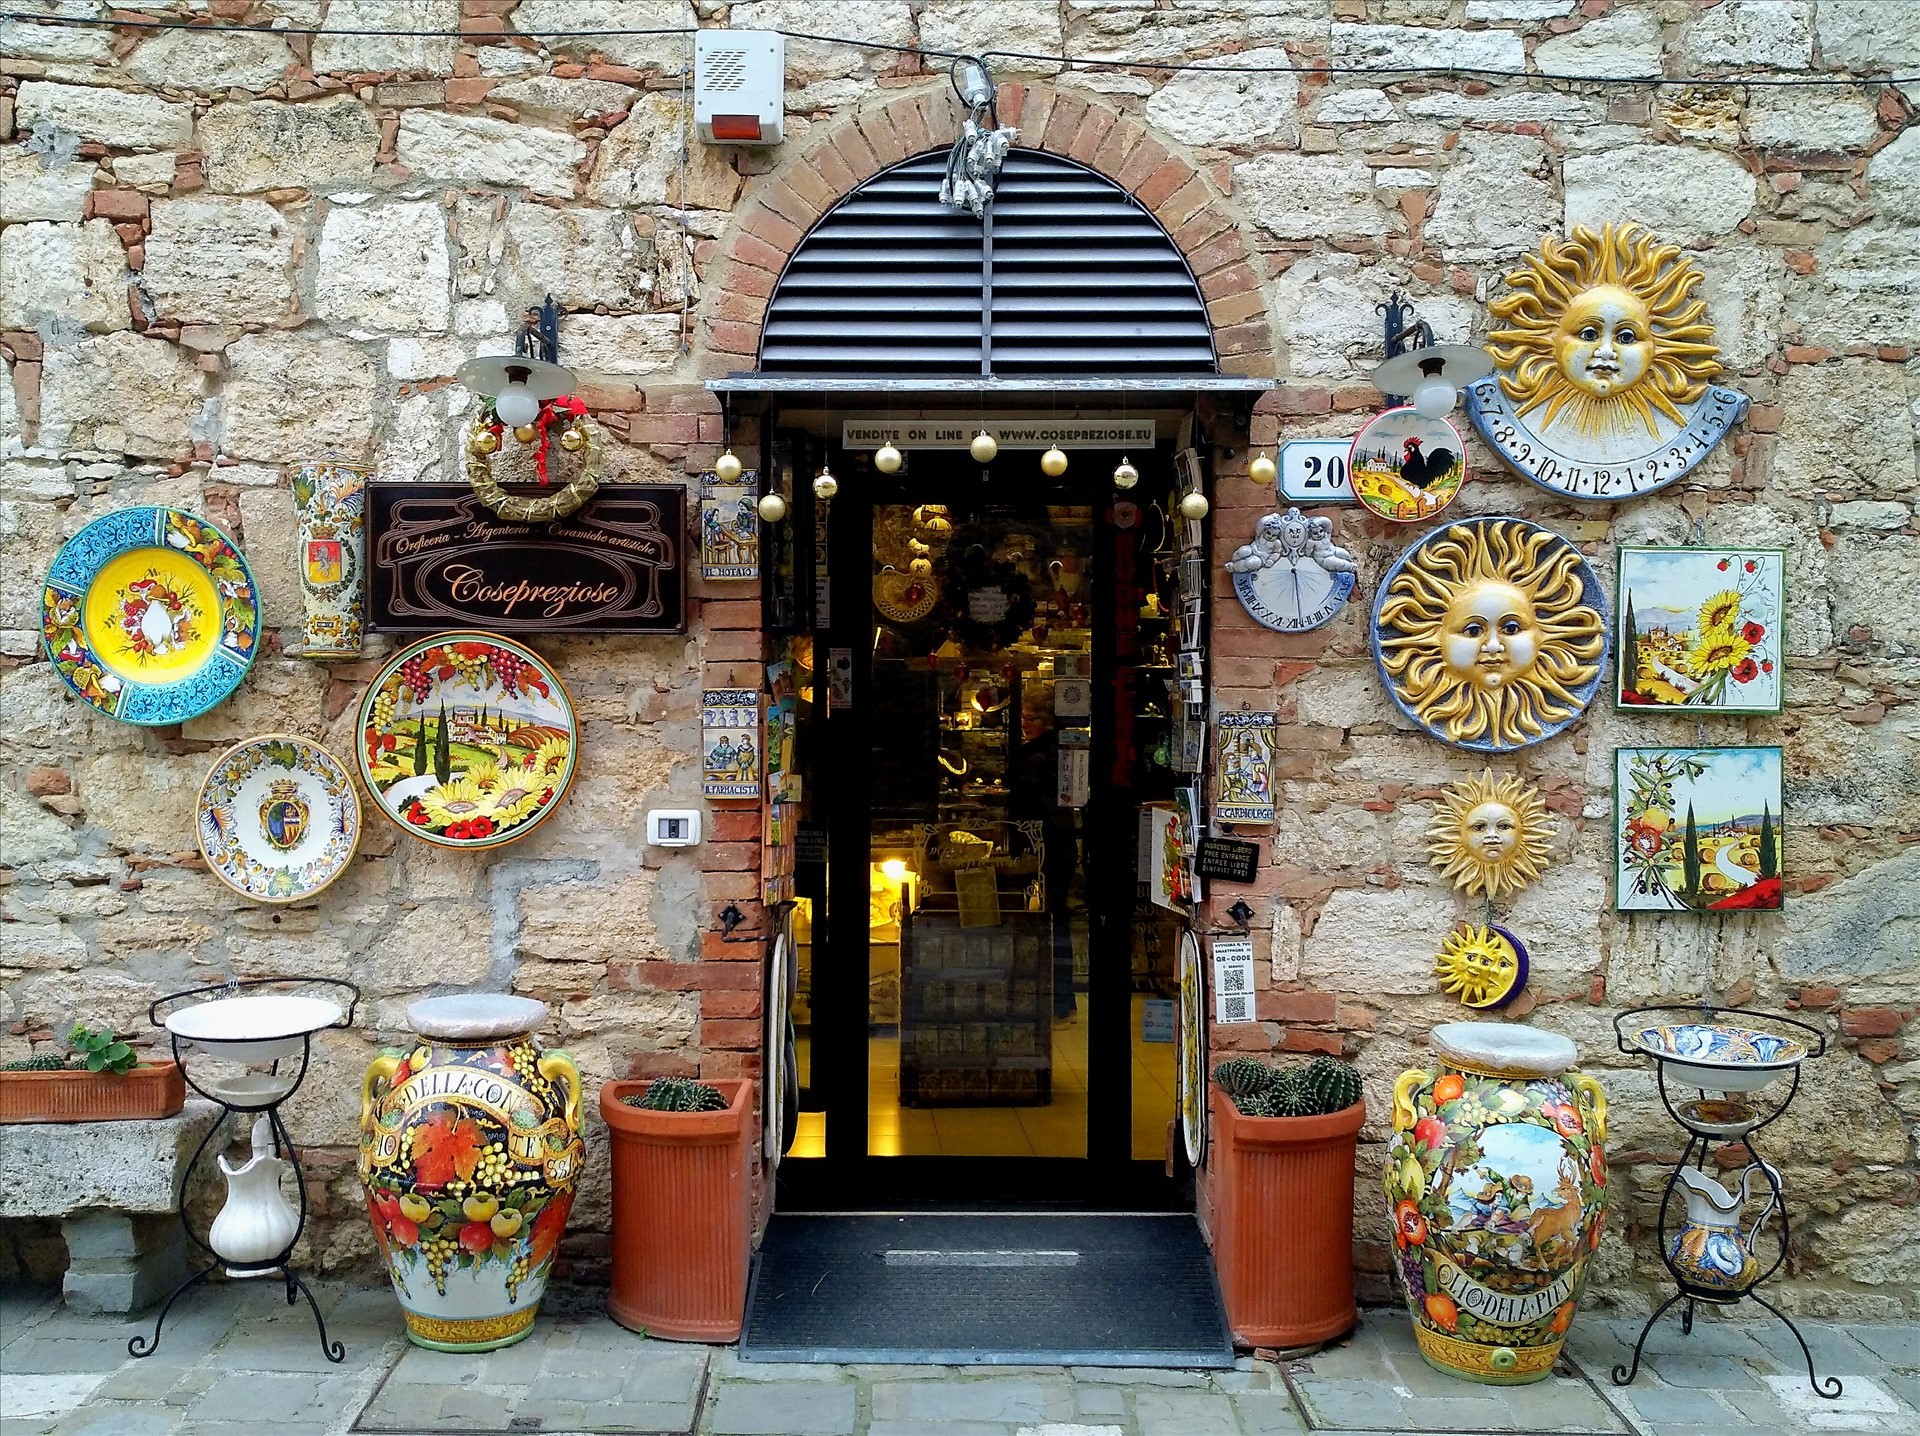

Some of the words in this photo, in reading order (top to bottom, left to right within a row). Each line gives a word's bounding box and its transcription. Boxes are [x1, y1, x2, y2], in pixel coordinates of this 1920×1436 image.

[847, 429, 899, 440] VENDITE
[908, 429, 927, 440] ON
[935, 429, 963, 440] LINE
[999, 429, 1151, 440] WWW.COSEPREZIOSE.EU
[1479, 404, 1504, 415] 7
[1494, 426, 1515, 443] 8
[1512, 444, 1531, 463] 9
[1535, 456, 1557, 483] 10
[1564, 467, 1581, 492] 11
[1592, 470, 1611, 495] 12
[1624, 468, 1638, 492] 1
[1646, 460, 1665, 484] 2
[1669, 447, 1687, 469] 3
[1688, 432, 1709, 449] 4
[1701, 412, 1725, 429] 5
[1304, 455, 1345, 488] 20
[463, 521, 529, 542] Argenteria
[546, 521, 608, 543] Ceramiche
[608, 536, 656, 555] artistiche
[705, 568, 714, 576] IL
[443, 563, 618, 618] Cosepreziose
[712, 785, 759, 795] FARMACISTA
[1225, 807, 1273, 819] CARDIOLOGO
[1204, 842, 1231, 851] INGRESSO
[1204, 850, 1219, 858] FREE
[1221, 852, 1251, 862] ENTRANCE
[1230, 861, 1249, 869] LIBRE
[1233, 869, 1248, 877] FREI
[1438, 1263, 1484, 1308] OLIO
